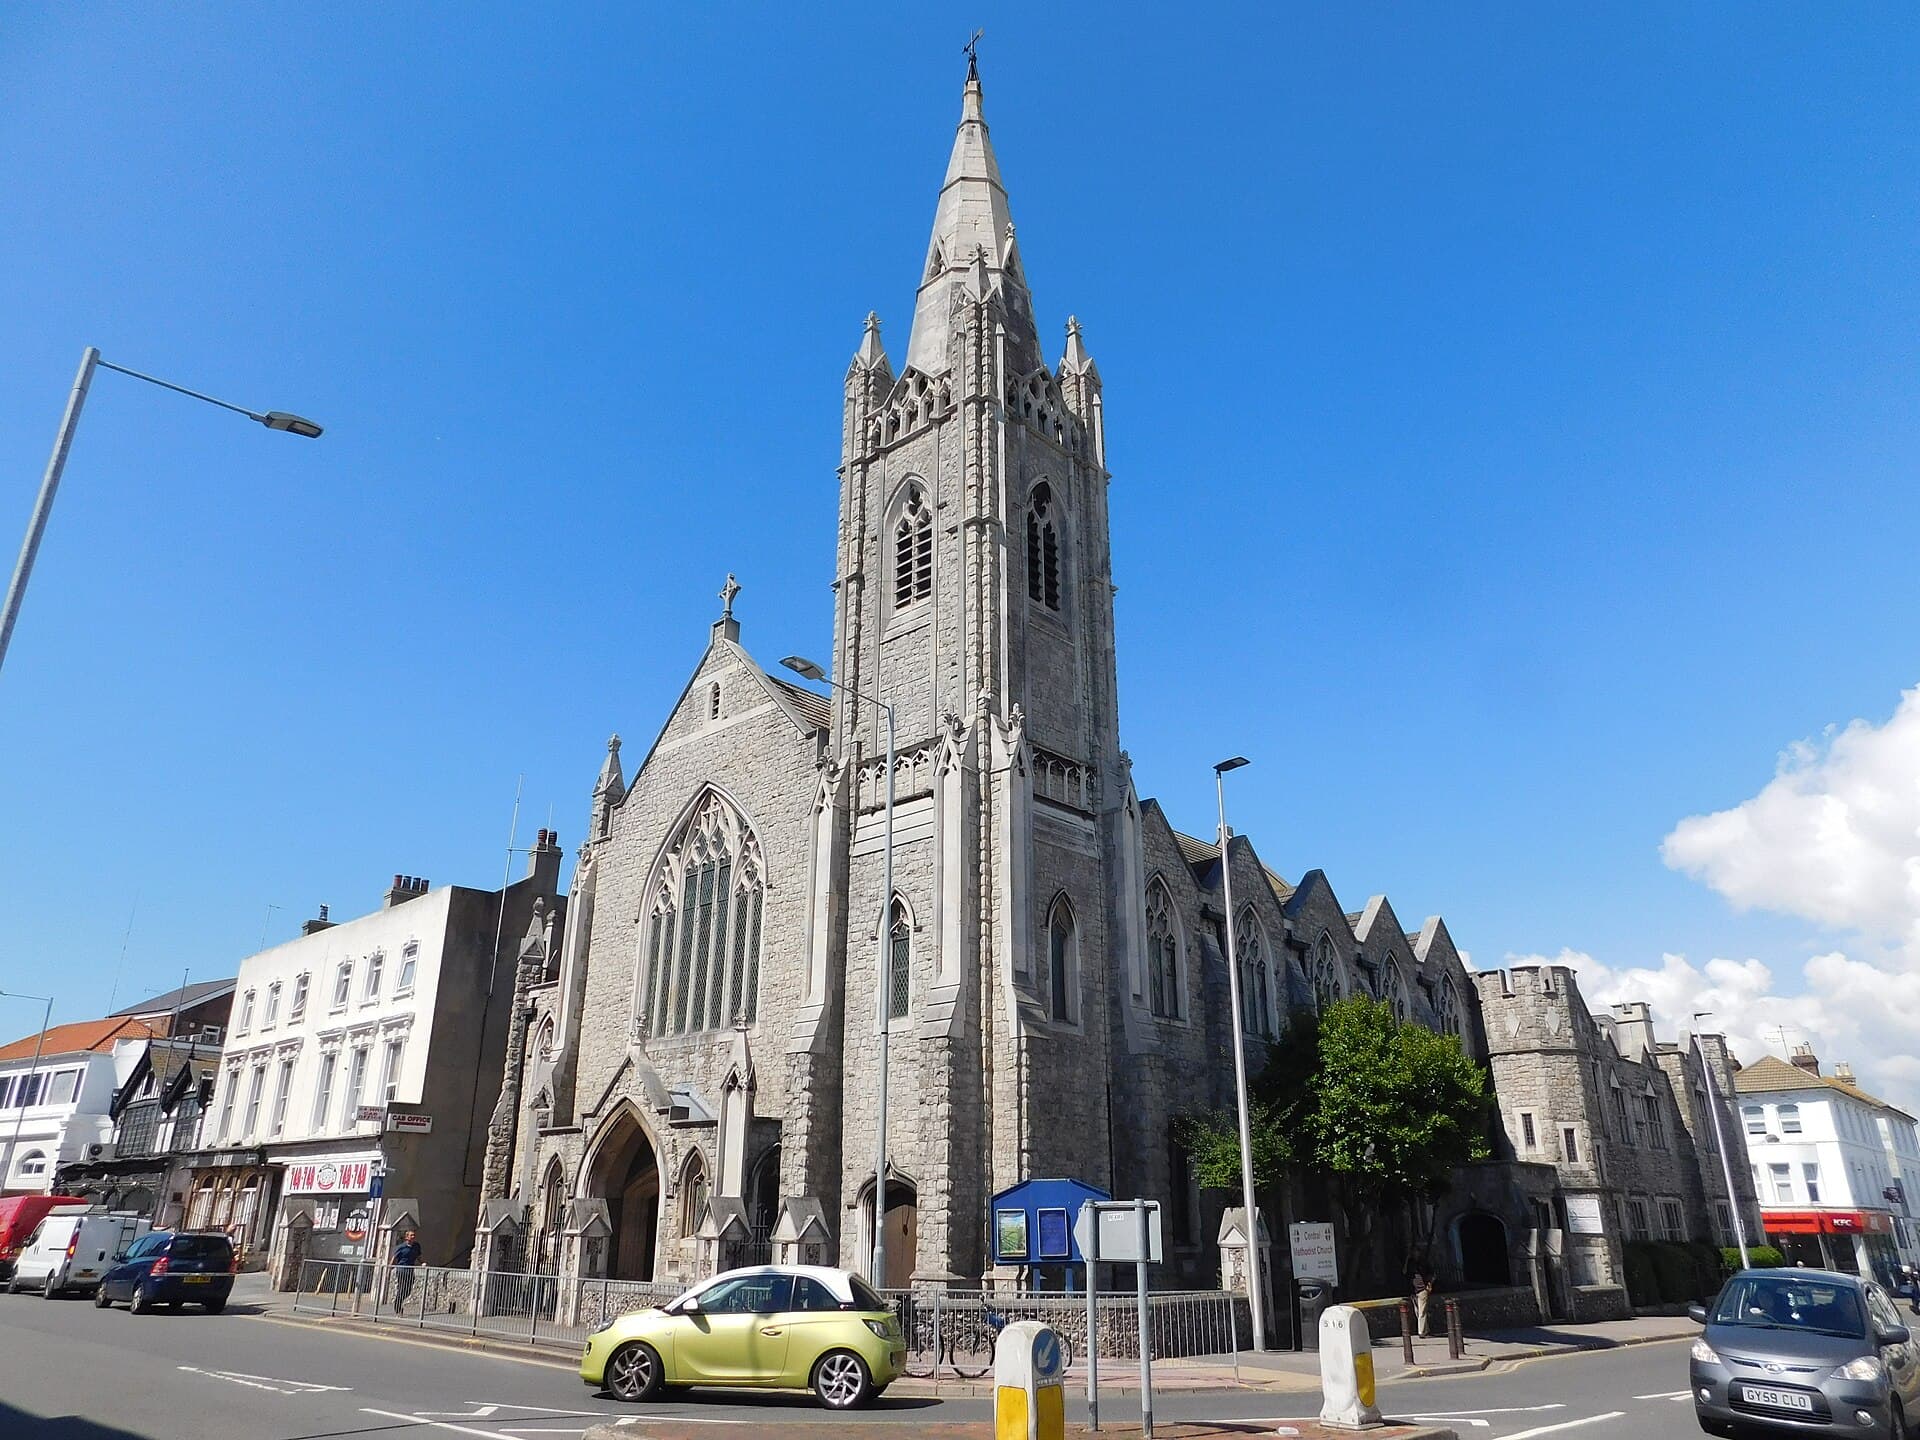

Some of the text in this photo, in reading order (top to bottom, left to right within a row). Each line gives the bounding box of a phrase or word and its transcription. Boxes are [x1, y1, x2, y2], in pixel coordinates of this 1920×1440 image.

[1304, 1231, 1321, 1241] Central
[1316, 1245, 1333, 1255] Church
[1746, 1389, 1807, 1408] GY59 CLO
